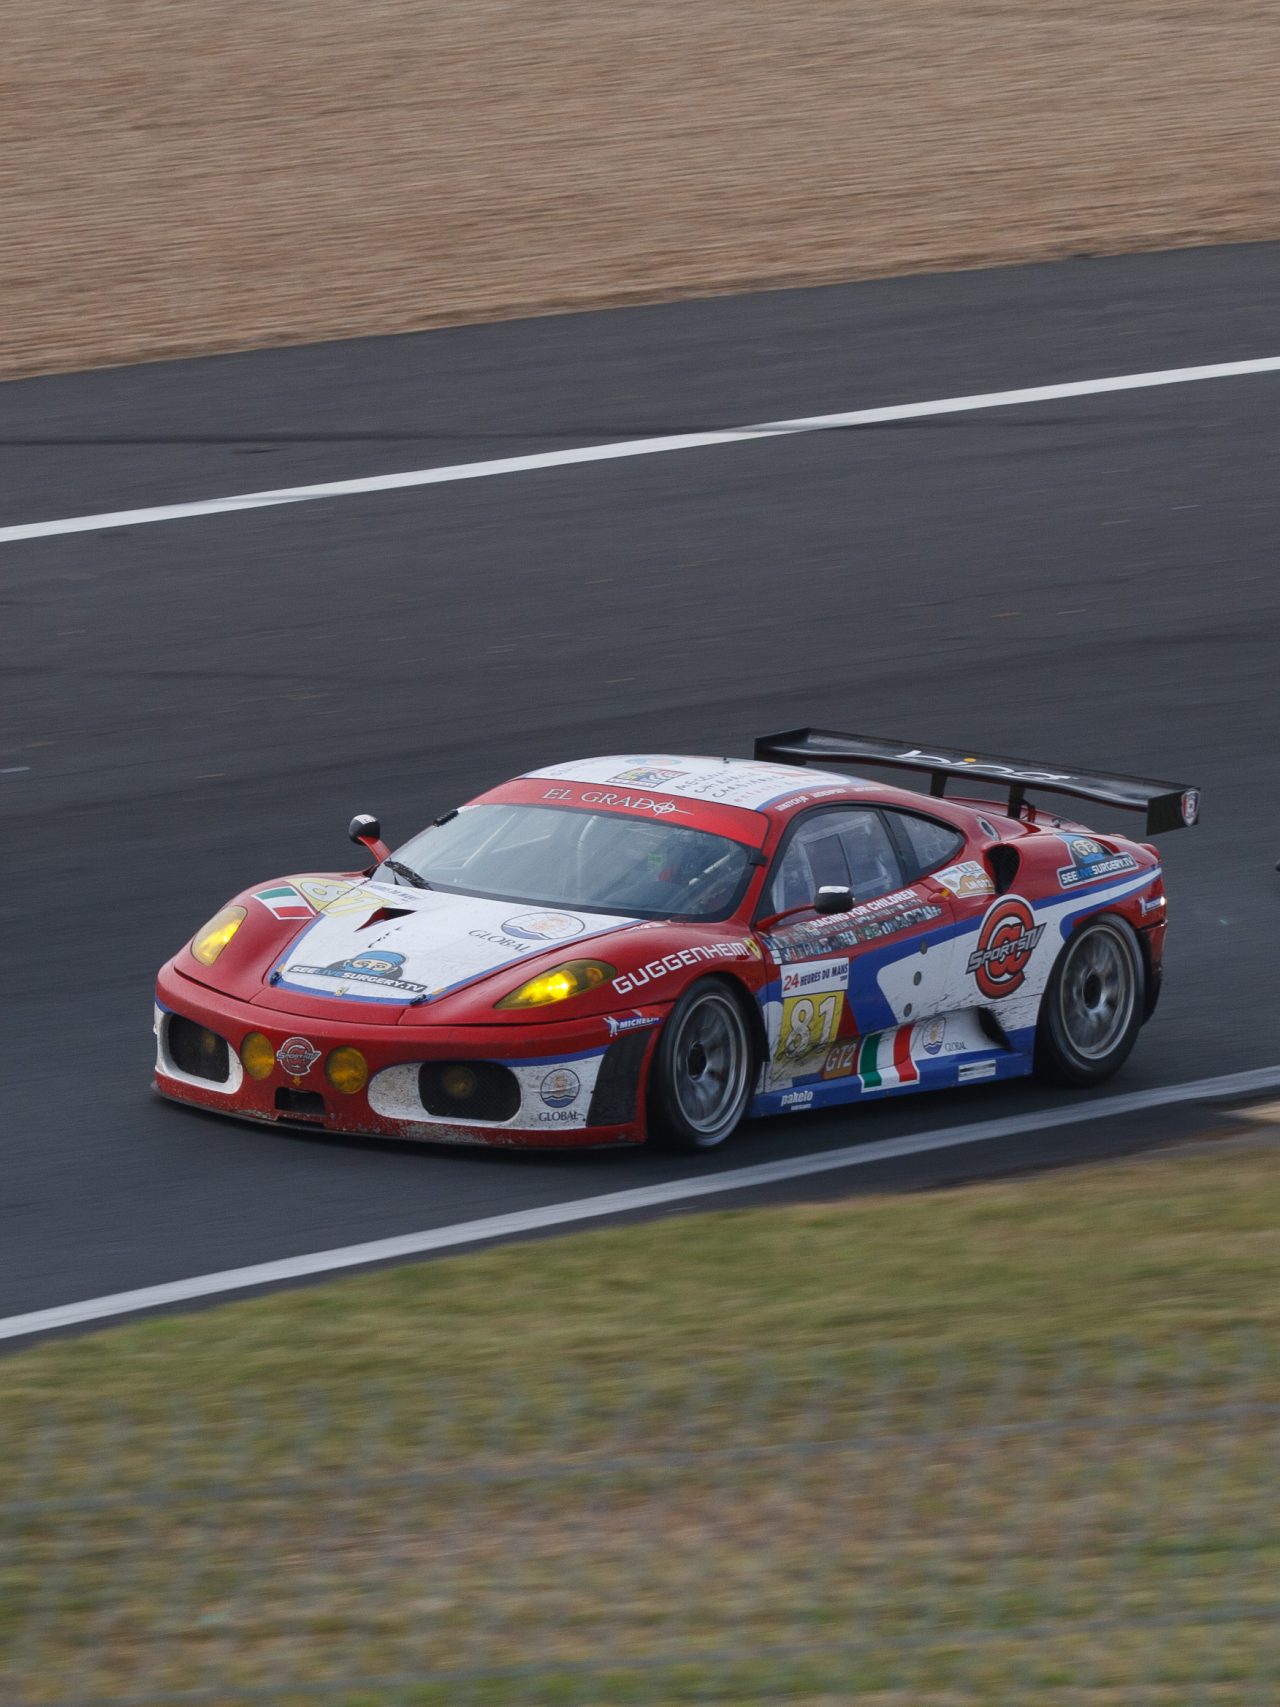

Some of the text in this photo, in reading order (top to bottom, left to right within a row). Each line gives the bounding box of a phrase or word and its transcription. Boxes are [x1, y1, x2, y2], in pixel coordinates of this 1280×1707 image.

[542, 788, 572, 801] EL
[1061, 857, 1134, 884] SEELIVESURGERY.TV
[812, 911, 849, 930] RACING
[848, 905, 870, 921] FOR
[868, 888, 919, 911] CHILDREN
[468, 928, 533, 952] GLOBAL
[291, 964, 426, 993] SEELIVESURGERY.TV
[611, 937, 751, 995] GUGGENHEIM
[783, 963, 849, 992] 24 HEURES DU MANS
[786, 996, 837, 1058] 81
[825, 1042, 858, 1073] GT2
[944, 1041, 967, 1052] GLOBAL
[538, 1111, 581, 1122] GLOBAL
